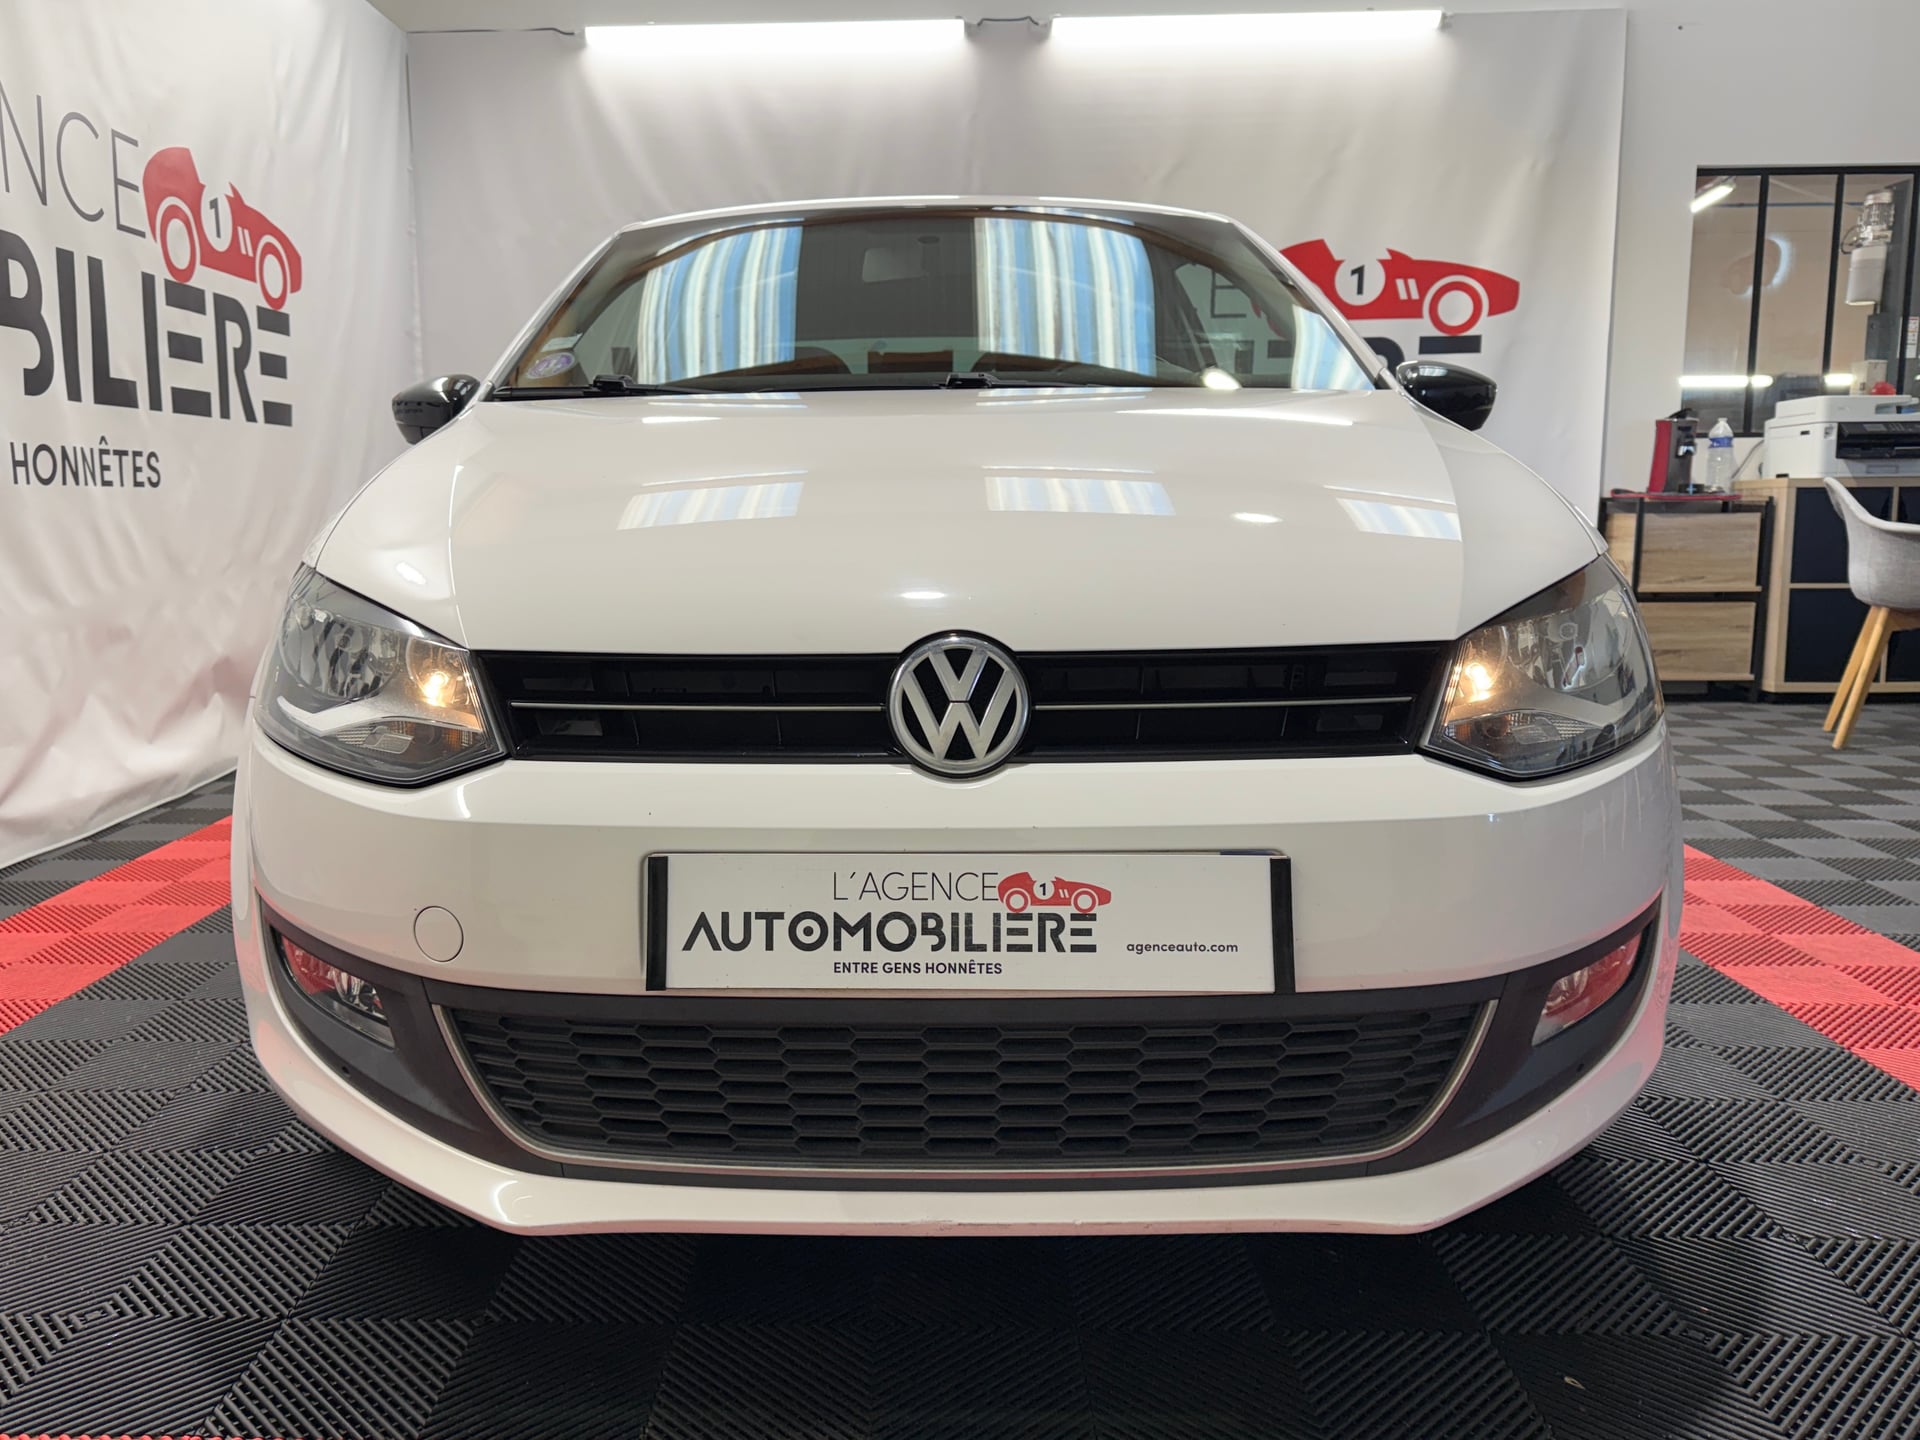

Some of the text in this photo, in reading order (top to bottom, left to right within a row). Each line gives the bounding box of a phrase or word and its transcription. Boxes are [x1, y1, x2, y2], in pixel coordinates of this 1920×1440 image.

[208, 197, 221, 239] 1
[1350, 264, 1365, 296] 1
[10, 435, 161, 488] HONNÊTES
[899, 644, 1018, 763] VW
[1039, 882, 1047, 896] 1
[682, 910, 1097, 953] AUTOMOBILIERE
[1126, 941, 1238, 955] agenceauto.com
[833, 959, 1003, 975] ENTRE GENS HONNÊTES
